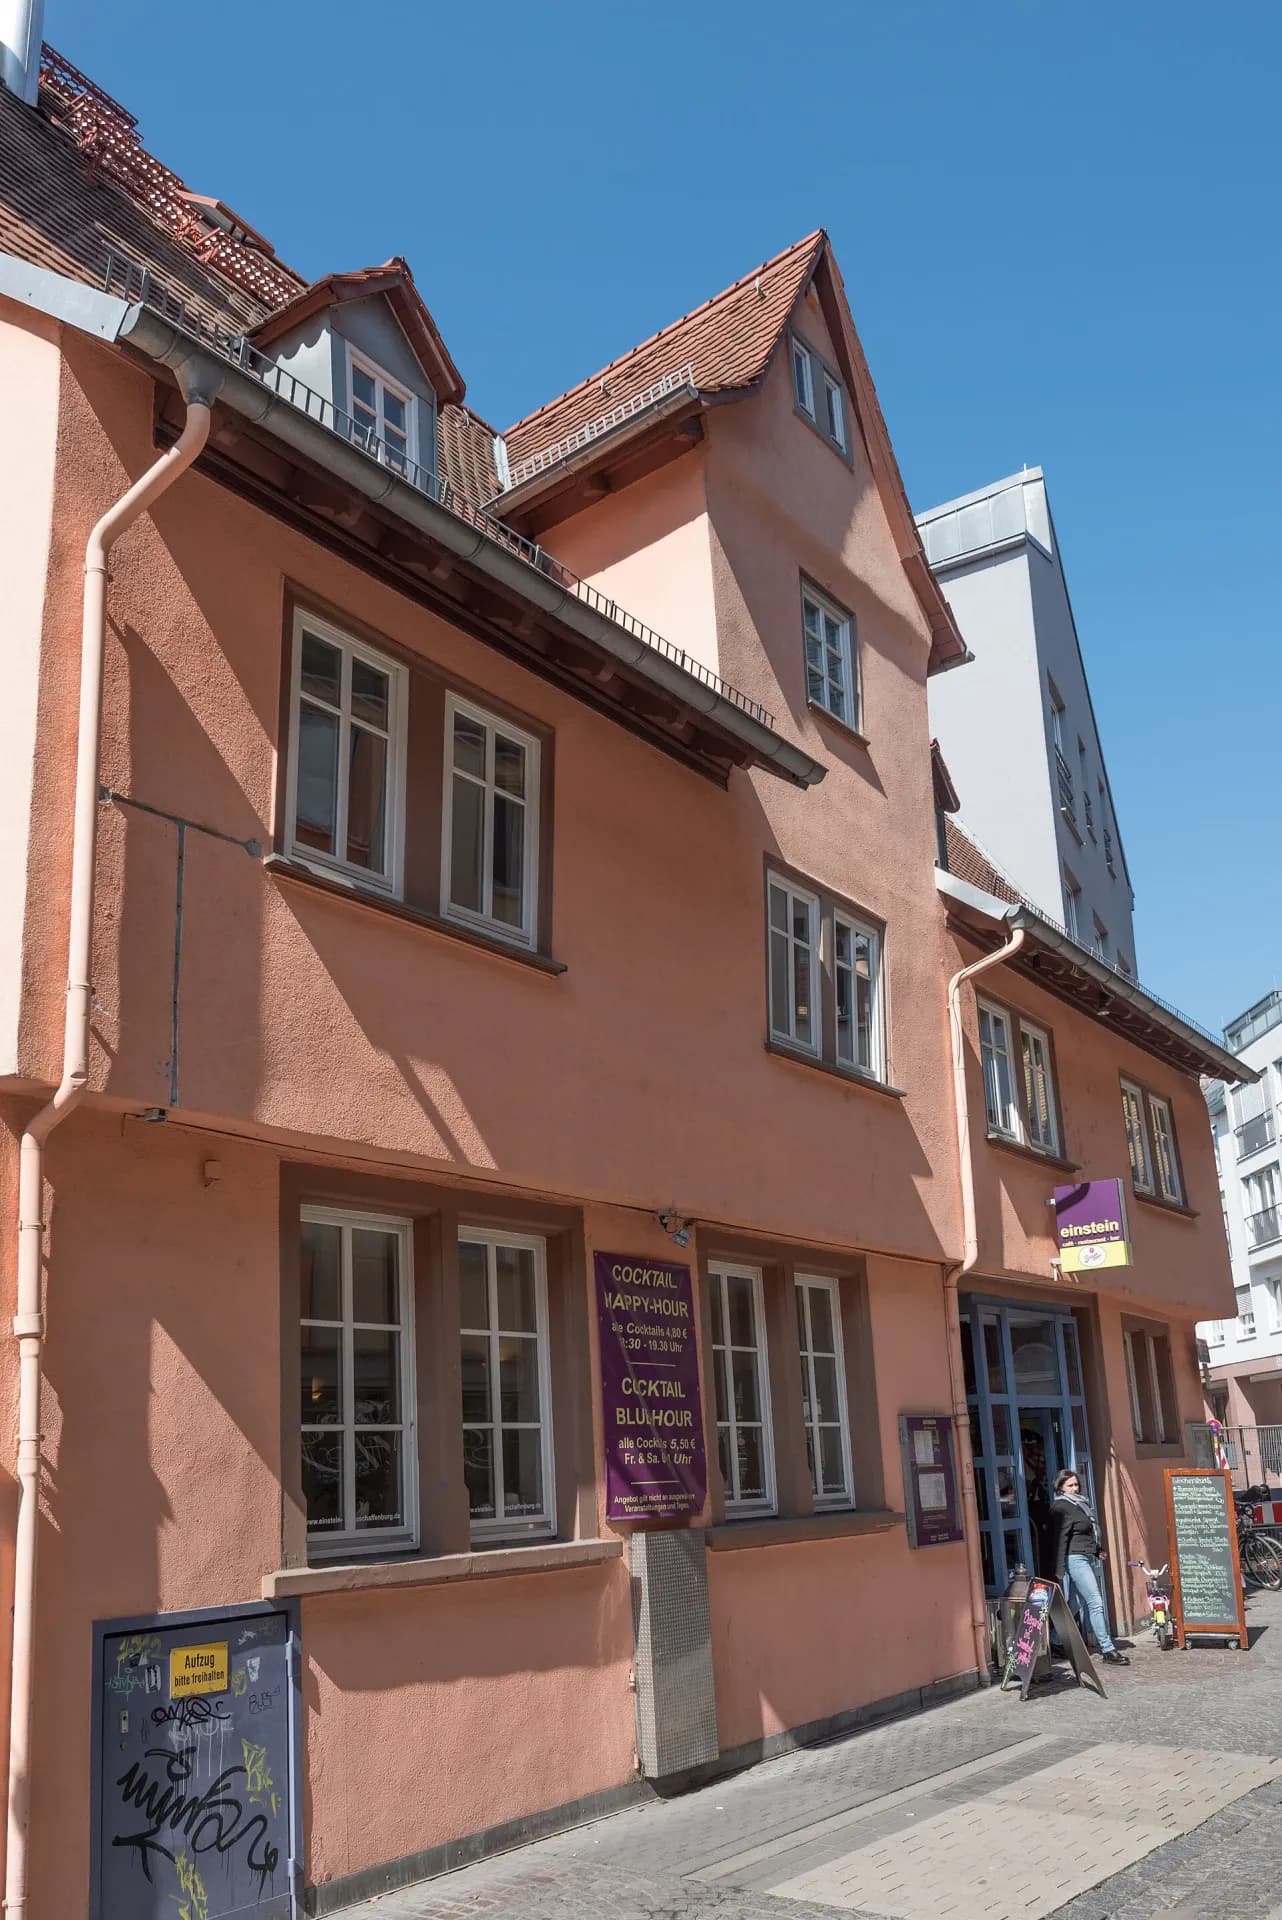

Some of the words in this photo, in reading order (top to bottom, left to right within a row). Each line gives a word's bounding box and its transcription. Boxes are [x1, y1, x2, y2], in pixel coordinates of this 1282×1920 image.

[1060, 1219, 1119, 1238] einstein
[612, 1265, 678, 1289] COCKTAIL
[627, 1323, 665, 1337] Cocktails
[666, 1327, 681, 1339] 4,80
[683, 1328, 688, 1340] €
[649, 1339, 668, 1352] 19.30
[670, 1341, 683, 1353] Uhr
[622, 1377, 686, 1398] COCKTAIL
[618, 1436, 634, 1449] alle
[670, 1438, 689, 1451] 5,50
[690, 1439, 696, 1449] €
[624, 1453, 636, 1465] Fr.
[638, 1452, 645, 1464] &
[647, 1452, 660, 1464] Sa.
[674, 1453, 693, 1465] Uhr
[614, 1495, 638, 1504] Angebot
[184, 1653, 215, 1669] Aufzug
[174, 1674, 190, 1687] bitte
[192, 1670, 225, 1684] freihalten
